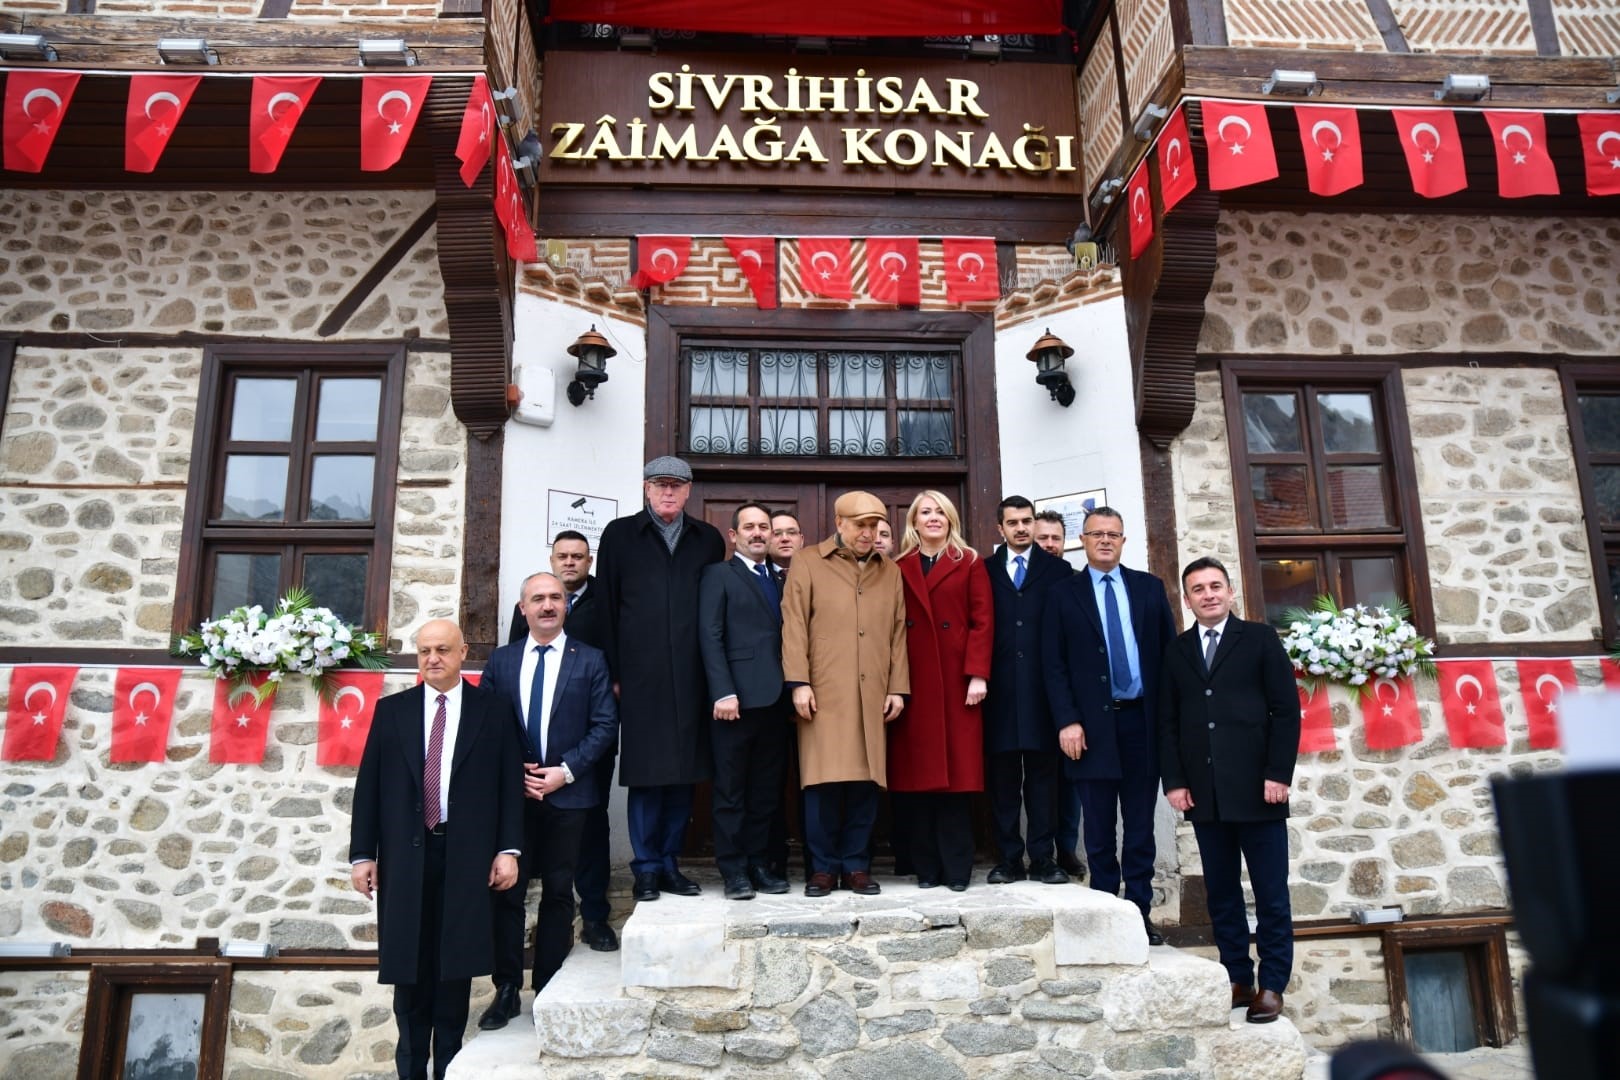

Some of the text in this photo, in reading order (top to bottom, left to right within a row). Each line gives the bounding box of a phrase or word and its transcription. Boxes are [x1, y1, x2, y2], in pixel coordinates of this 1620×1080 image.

[648, 64, 989, 117] SİVRİHİSAR
[549, 114, 1077, 172] ZÂİMAĞA KONAĞI
